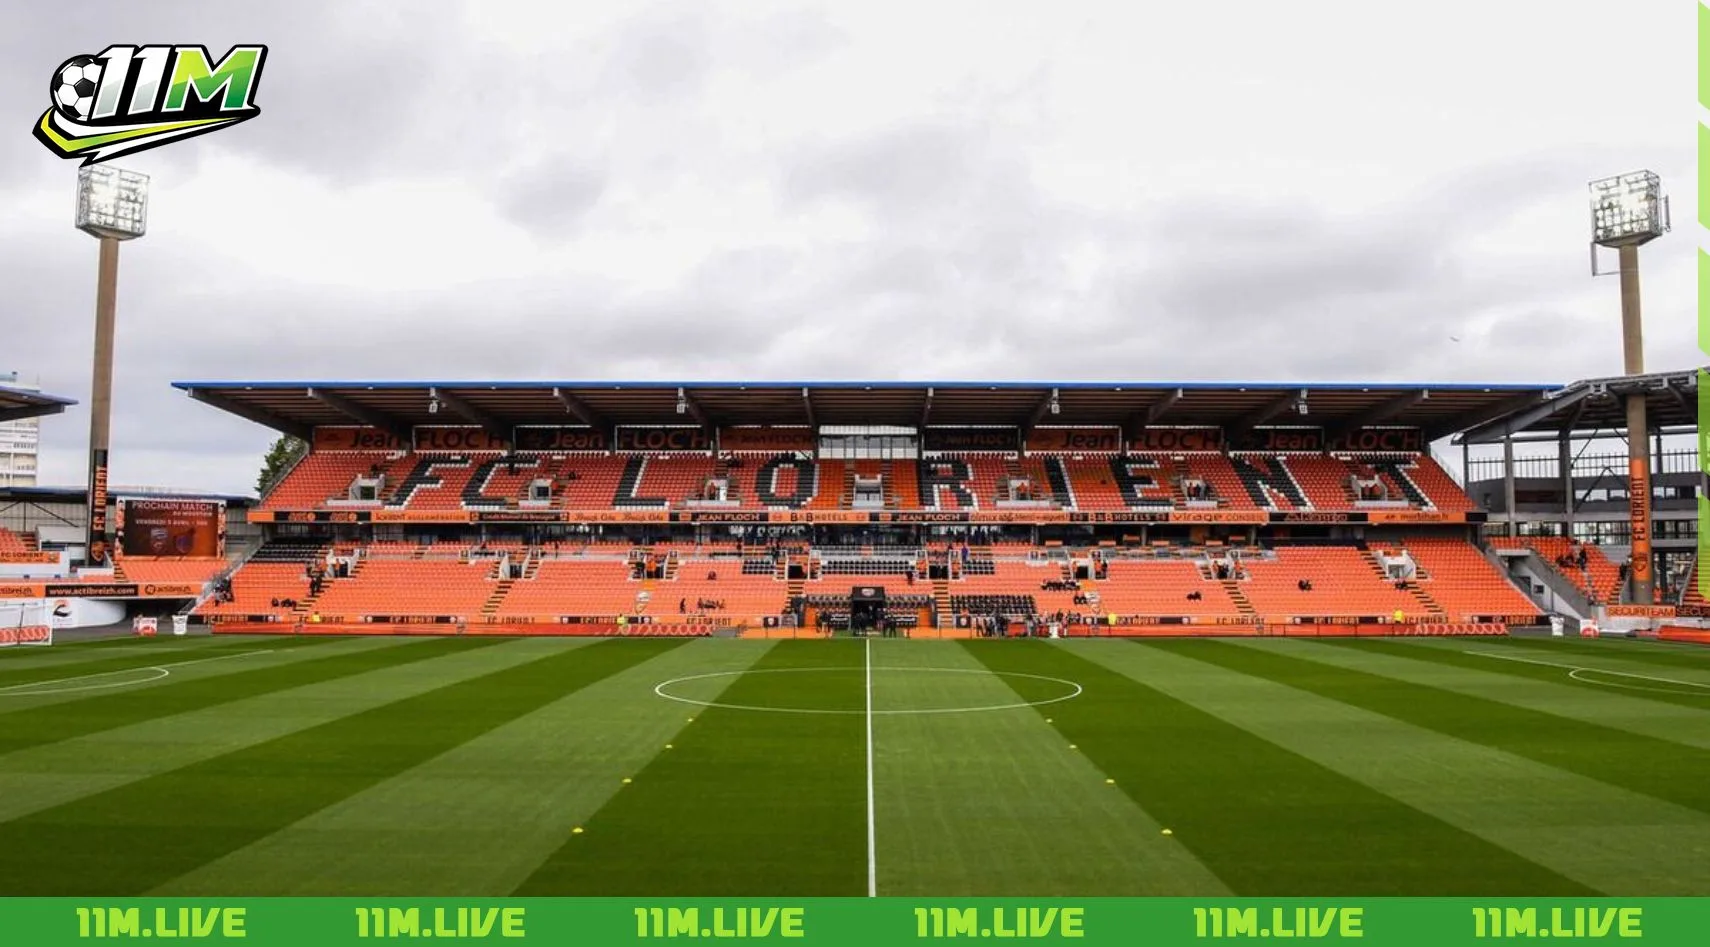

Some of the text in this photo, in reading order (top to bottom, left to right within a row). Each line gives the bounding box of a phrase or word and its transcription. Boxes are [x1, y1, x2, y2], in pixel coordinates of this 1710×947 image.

[550, 430, 603, 448] Jean
[1059, 431, 1114, 449] Jean
[132, 501, 213, 511] PROCHAIN MATCH
[1631, 477, 1646, 541] FC LORIENT
[49, 587, 135, 595] www.actibreizh.com
